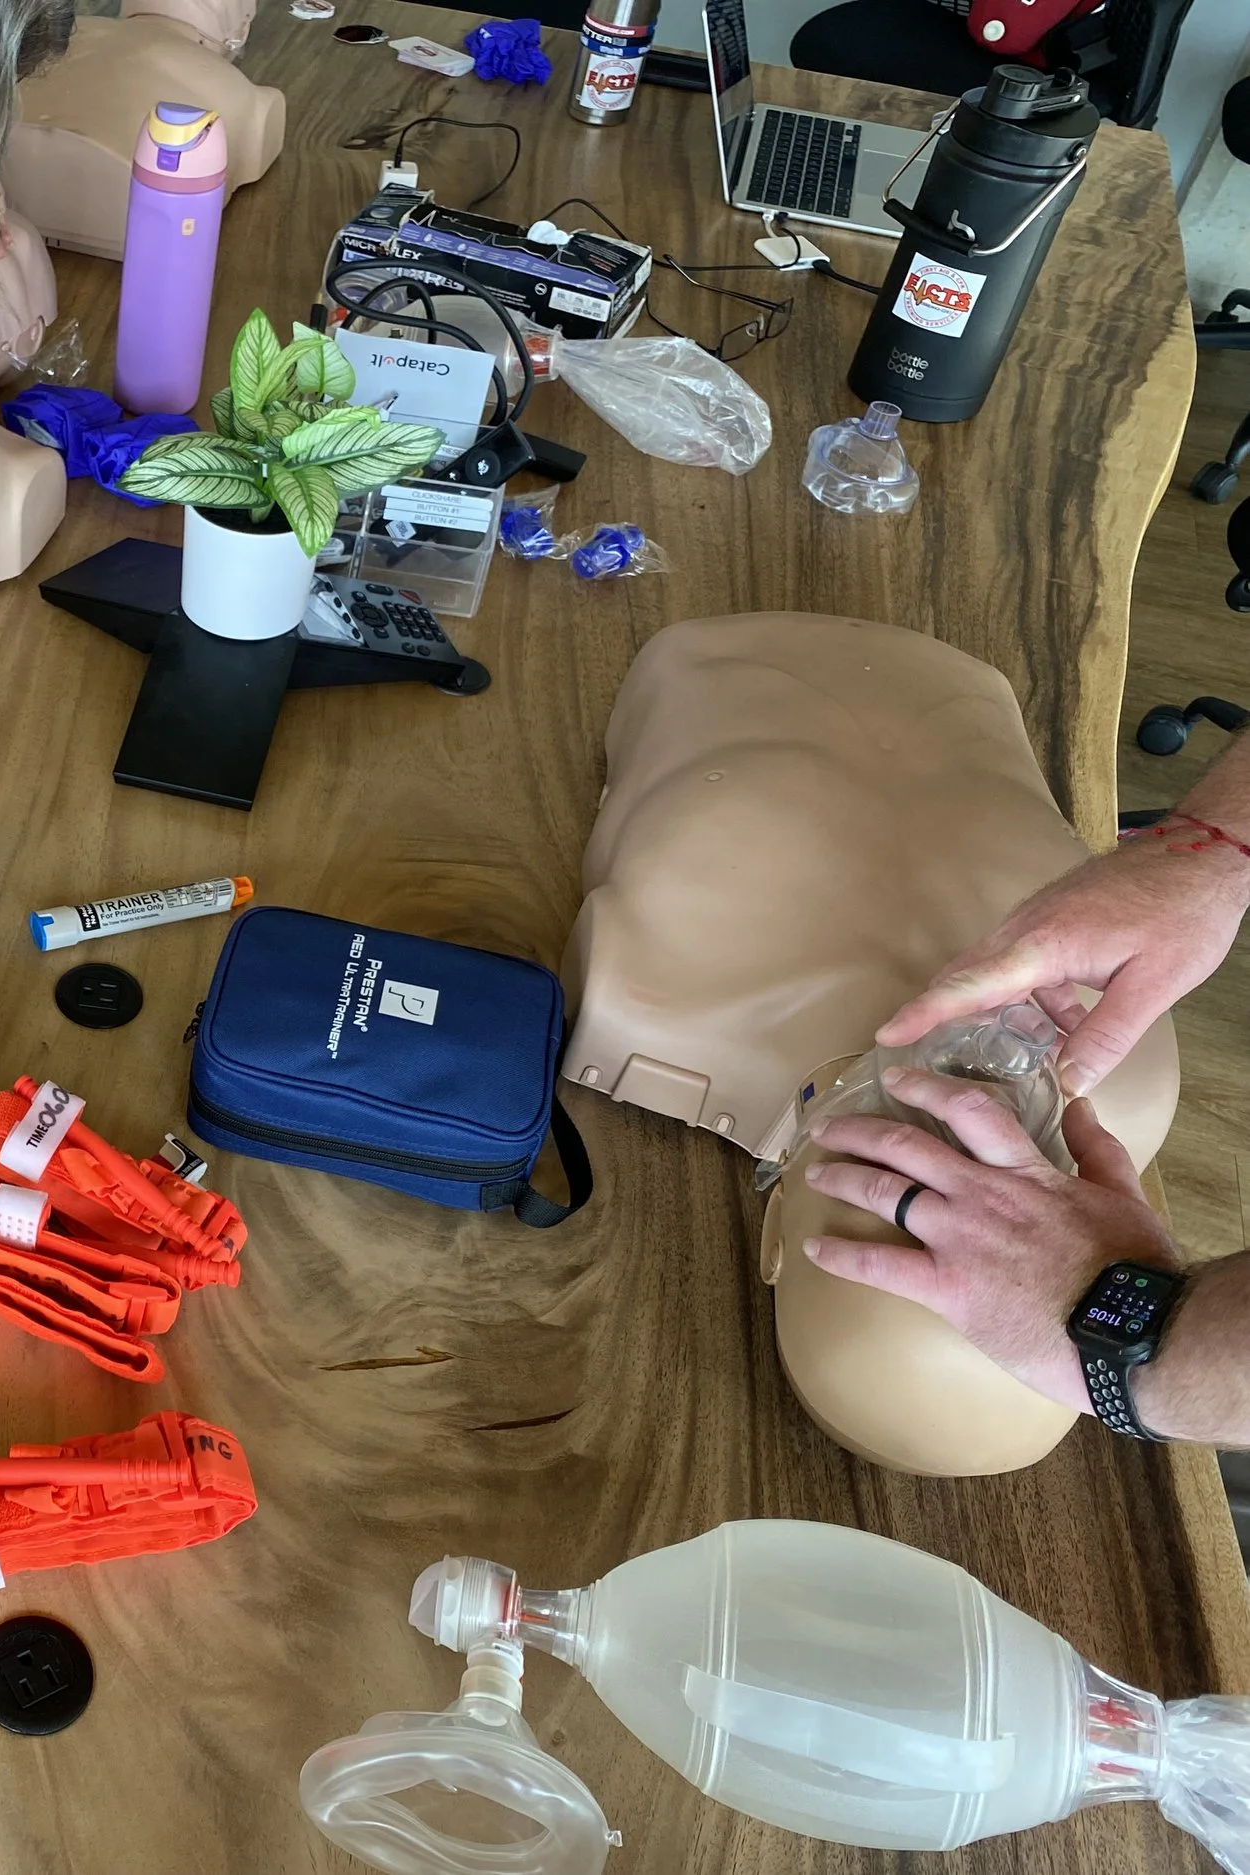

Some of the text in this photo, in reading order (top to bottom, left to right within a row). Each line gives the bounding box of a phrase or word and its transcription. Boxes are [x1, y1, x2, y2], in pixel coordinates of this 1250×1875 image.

[891, 347, 929, 370] bottle
[886, 360, 925, 381] bottle
[416, 503, 450, 513] BUTTON
[414, 514, 448, 524] BUTTON
[95, 892, 163, 913] TRAINER
[100, 903, 165, 920] For Practice Only
[349, 933, 366, 959] AED
[1087, 1307, 1122, 1327] 11:05
